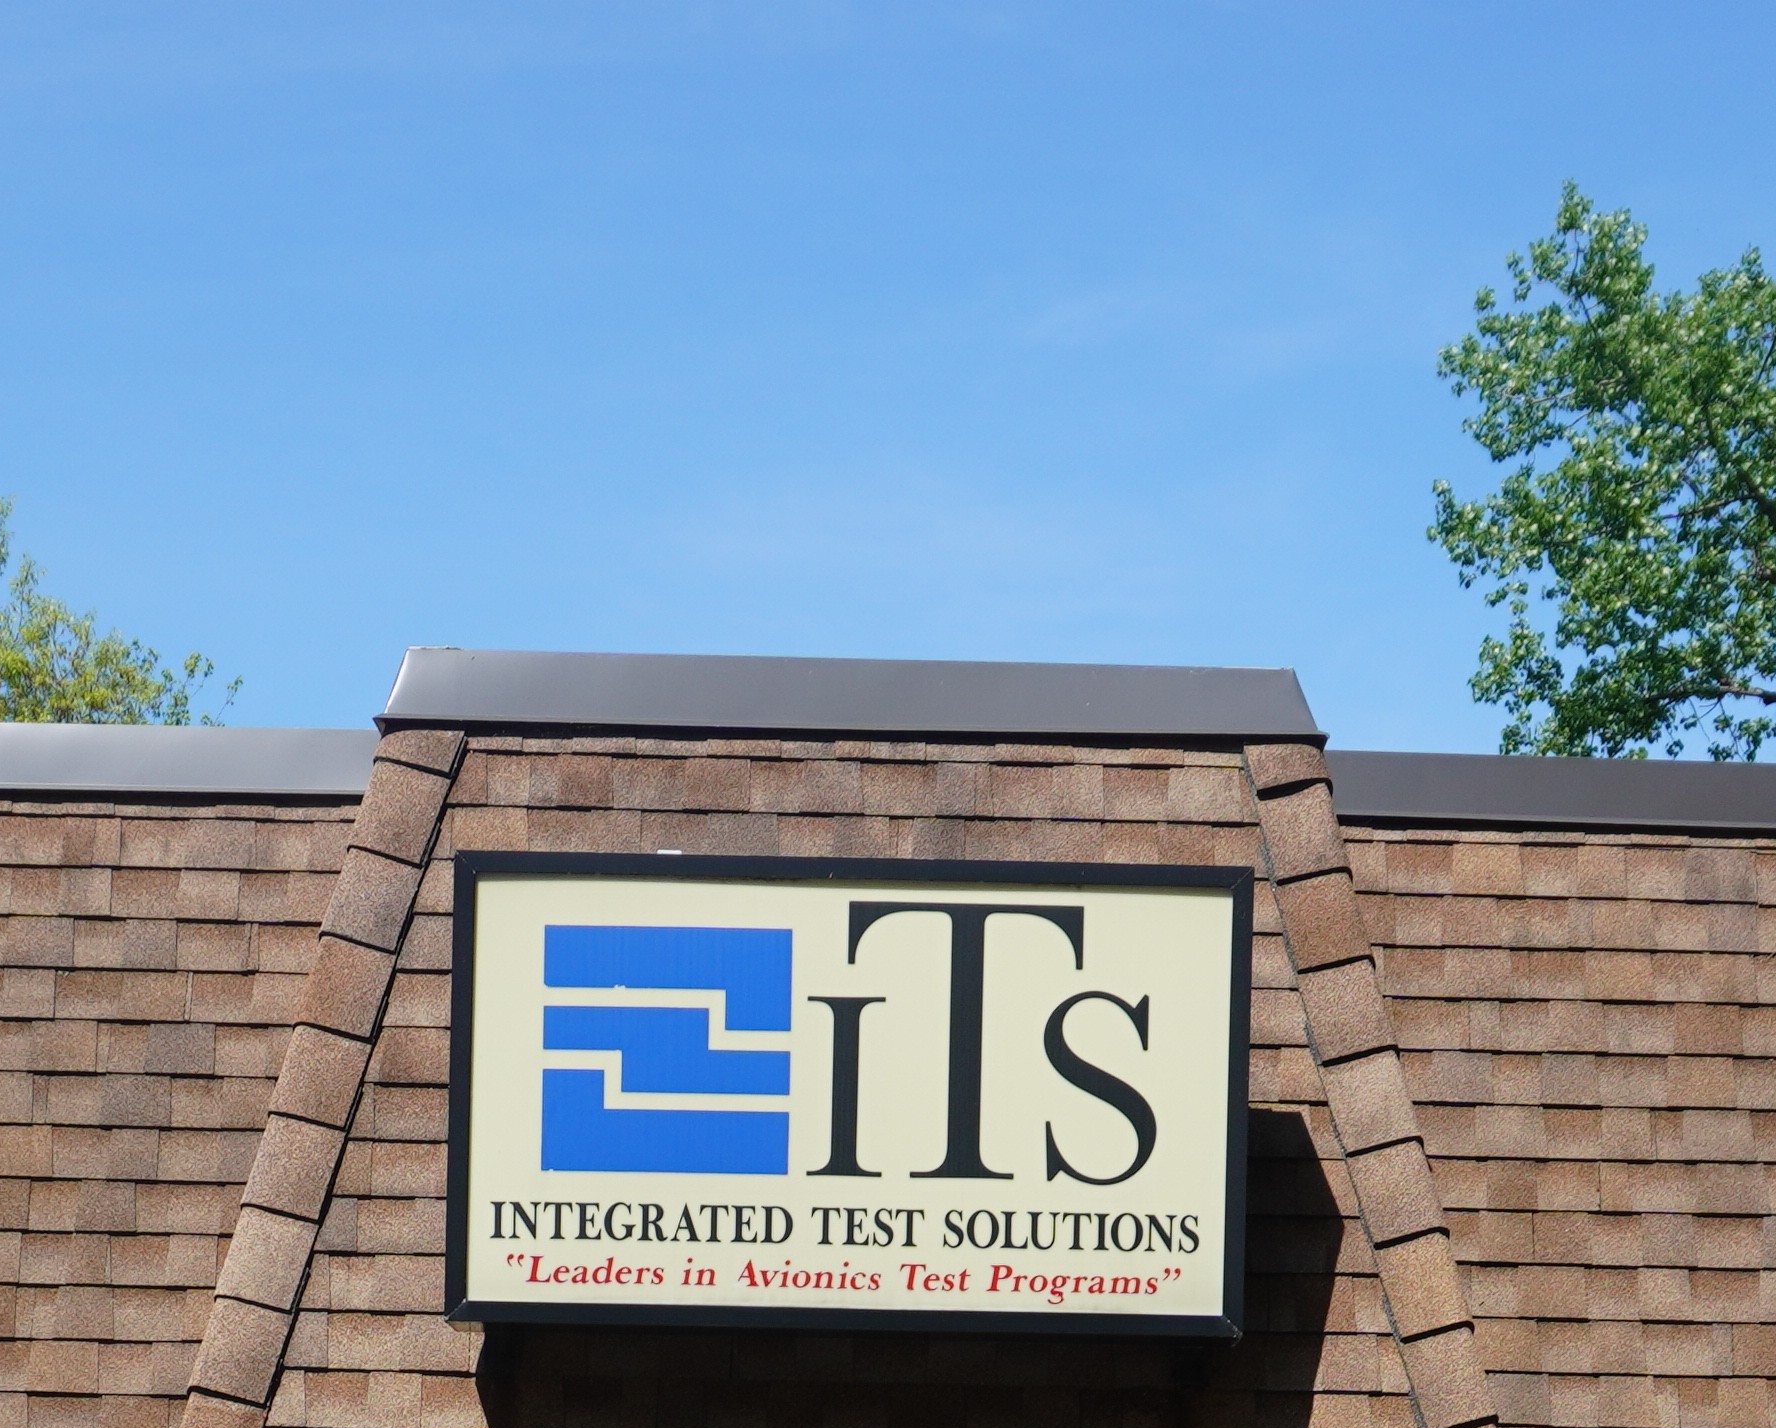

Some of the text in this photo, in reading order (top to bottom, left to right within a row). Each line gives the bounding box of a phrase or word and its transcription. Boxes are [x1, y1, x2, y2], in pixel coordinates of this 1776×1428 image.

[806, 901, 1157, 1186] ITS
[490, 1201, 1201, 1254] INTEGRATED TEST SOLUTIONS
[681, 1257, 717, 1287] in
[737, 1259, 882, 1291] Avionics
[900, 1263, 970, 1293] Test
